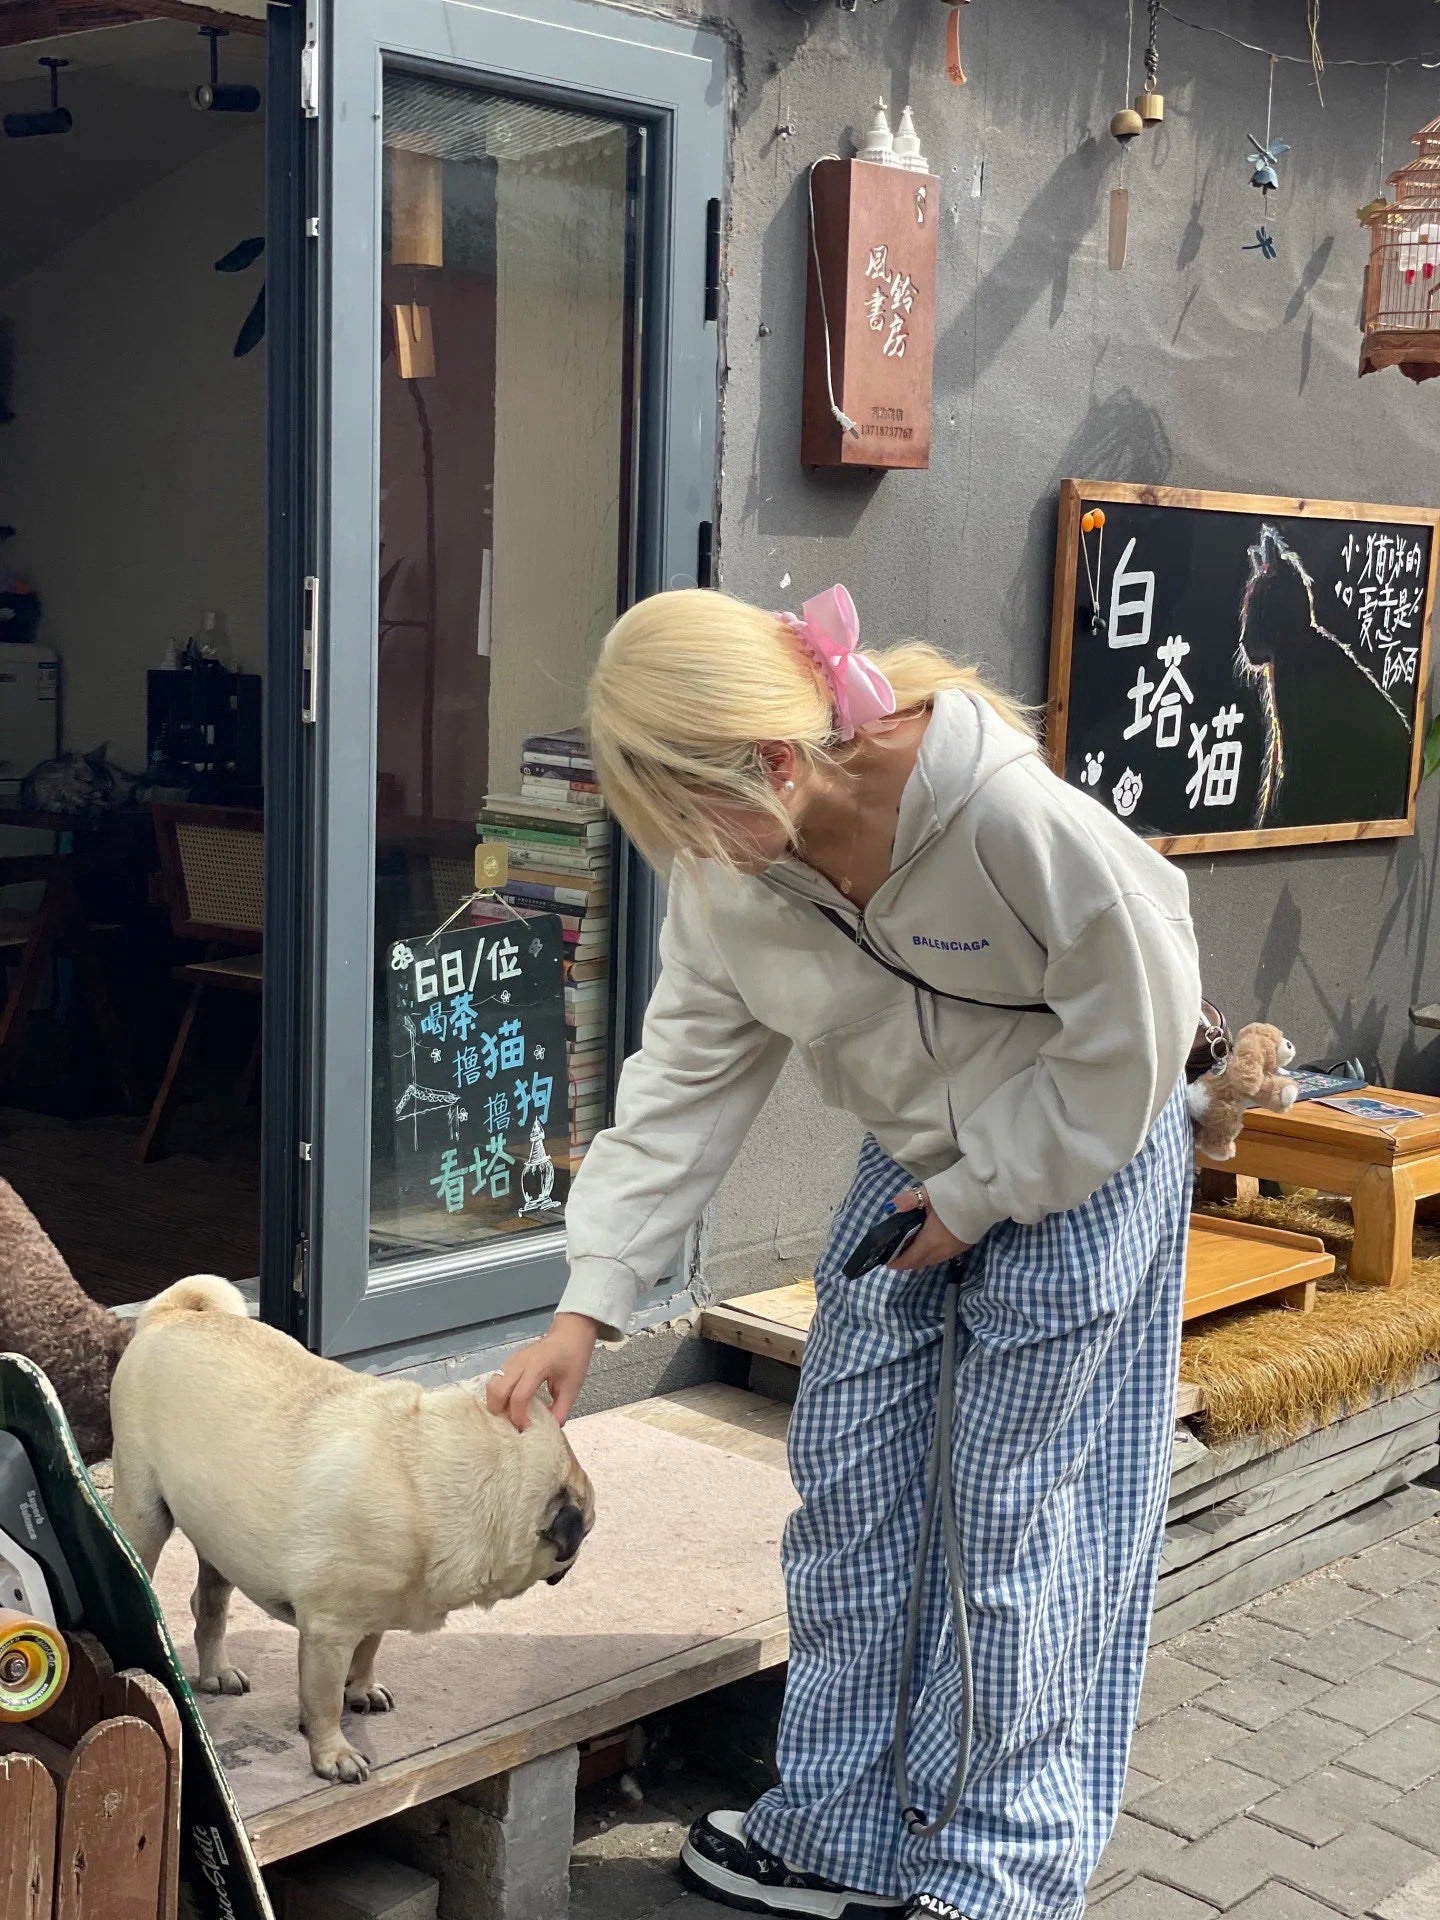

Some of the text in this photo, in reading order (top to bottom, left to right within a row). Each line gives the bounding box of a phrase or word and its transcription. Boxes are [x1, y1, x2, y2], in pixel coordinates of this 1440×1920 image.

[1341, 532, 1421, 585] 小猫咪的
[1108, 536, 1245, 810] 白塔猫
[1378, 640, 1419, 691] 百分百
[415, 937, 523, 1003] 68/位
[912, 935, 990, 952] BALENCIAGA
[421, 991, 478, 1042] 喝茶
[452, 1018, 525, 1089] 撸猫
[483, 1071, 553, 1134] 撸狗
[430, 1134, 516, 1213] 看塔
[27, 1490, 44, 1525] Superb
[928, 1897, 954, 1916] LV
